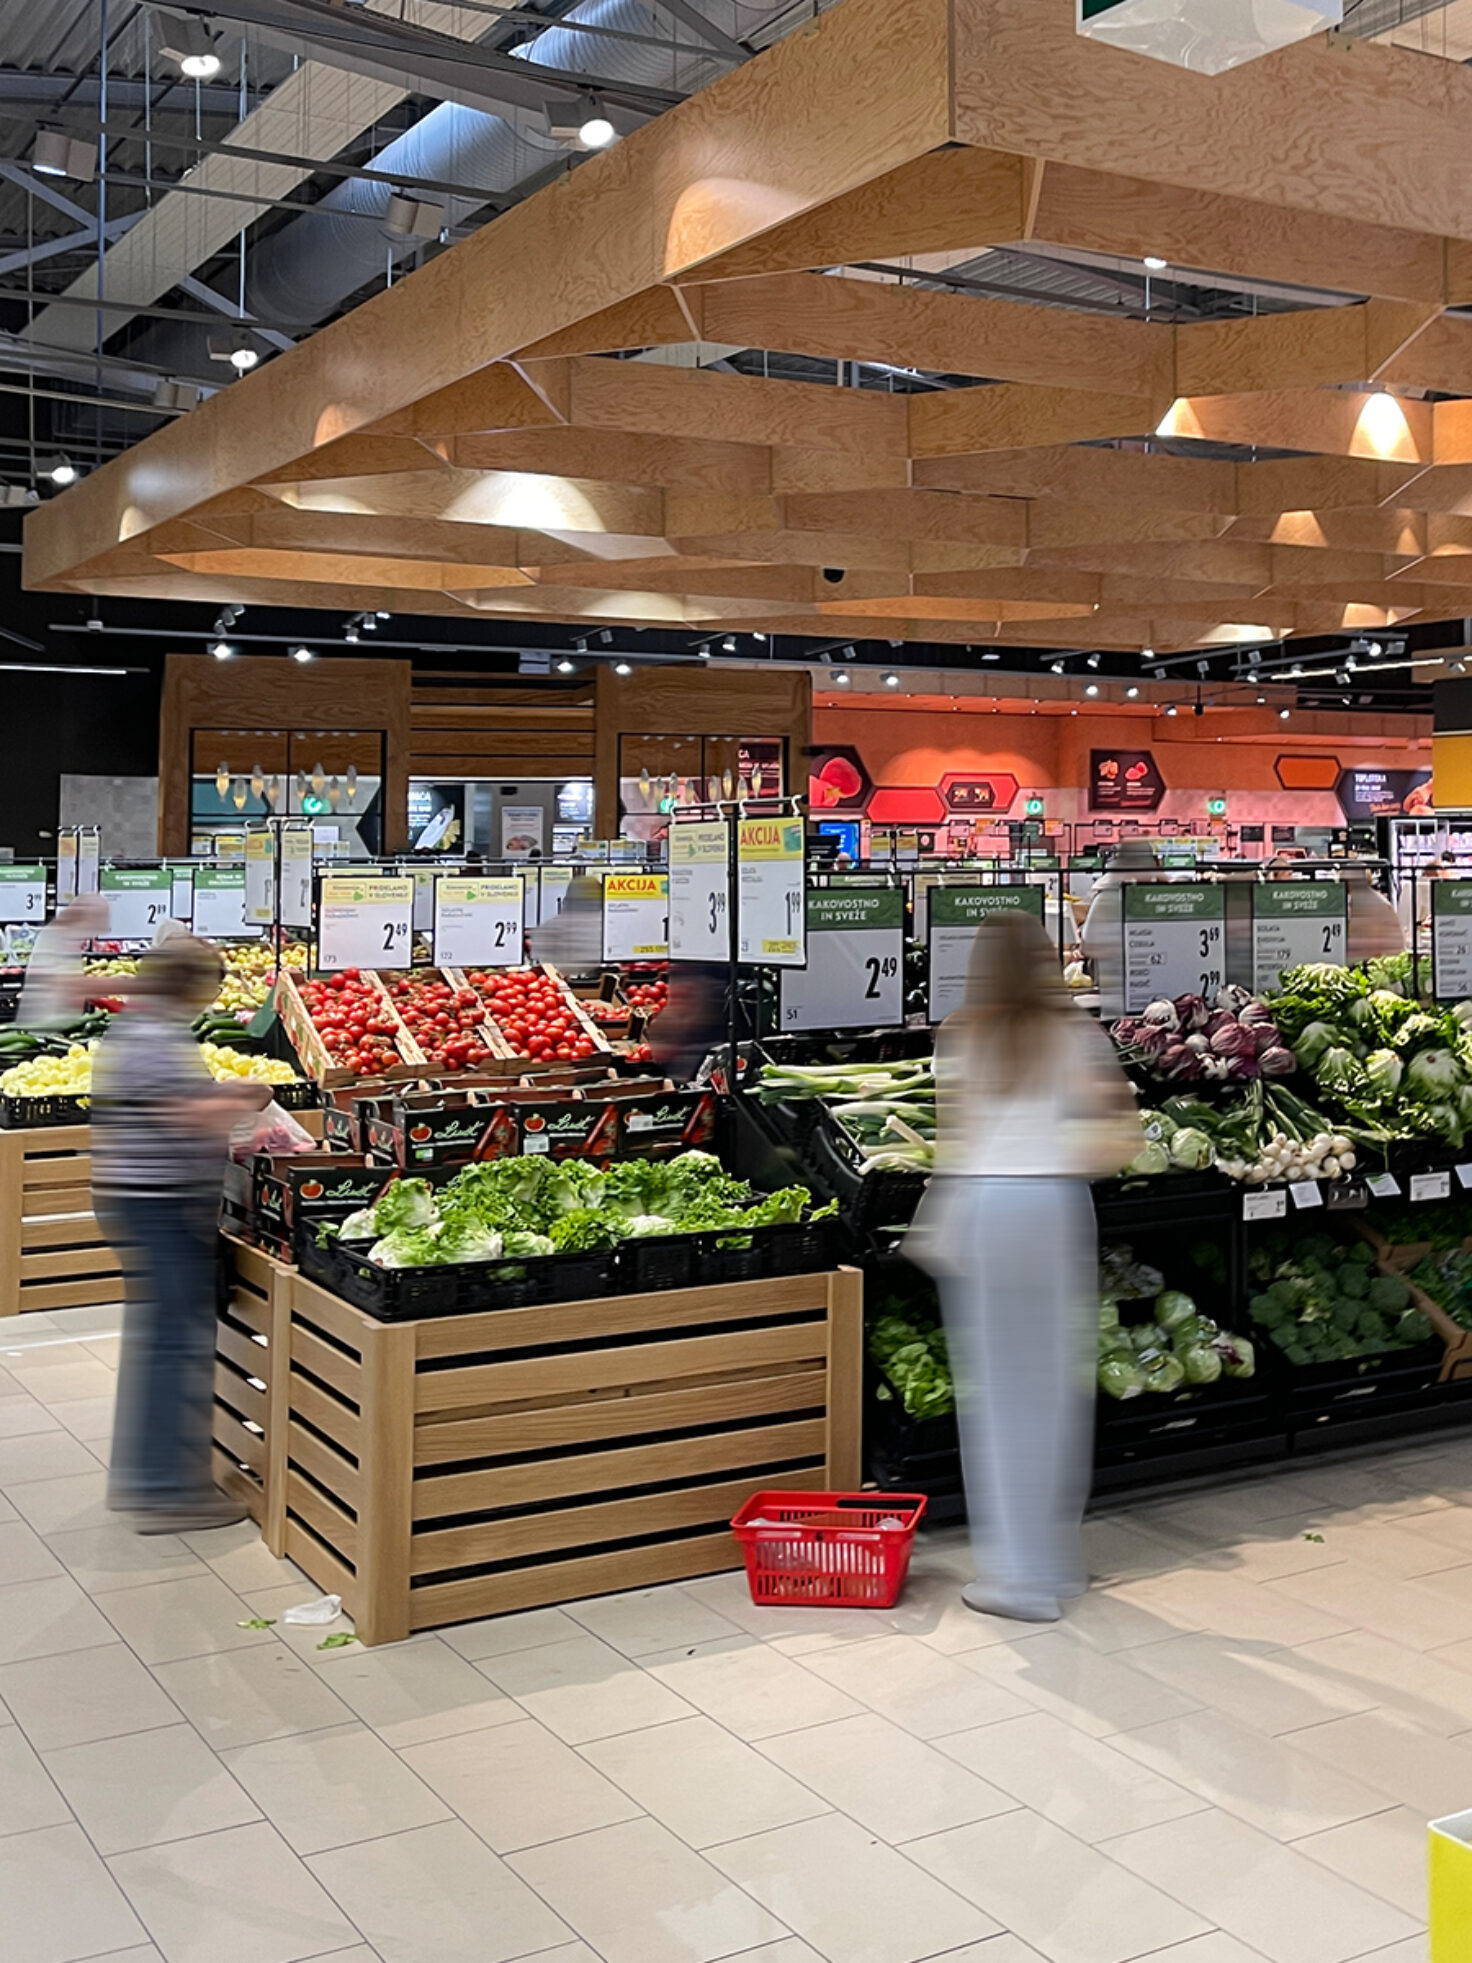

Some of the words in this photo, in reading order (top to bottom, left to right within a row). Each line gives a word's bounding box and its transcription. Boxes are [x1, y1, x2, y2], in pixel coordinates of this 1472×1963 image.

[740, 826, 780, 846] AKCIJA
[607, 879, 657, 891] AKCIJA
[808, 898, 881, 910] KAKOVOSTNO
[954, 895, 1020, 906] KAKOVOSTNO
[821, 911, 833, 921] IN
[835, 909, 867, 921] SVEŽE
[966, 908, 977, 917] IN
[865, 957, 898, 999] 249
